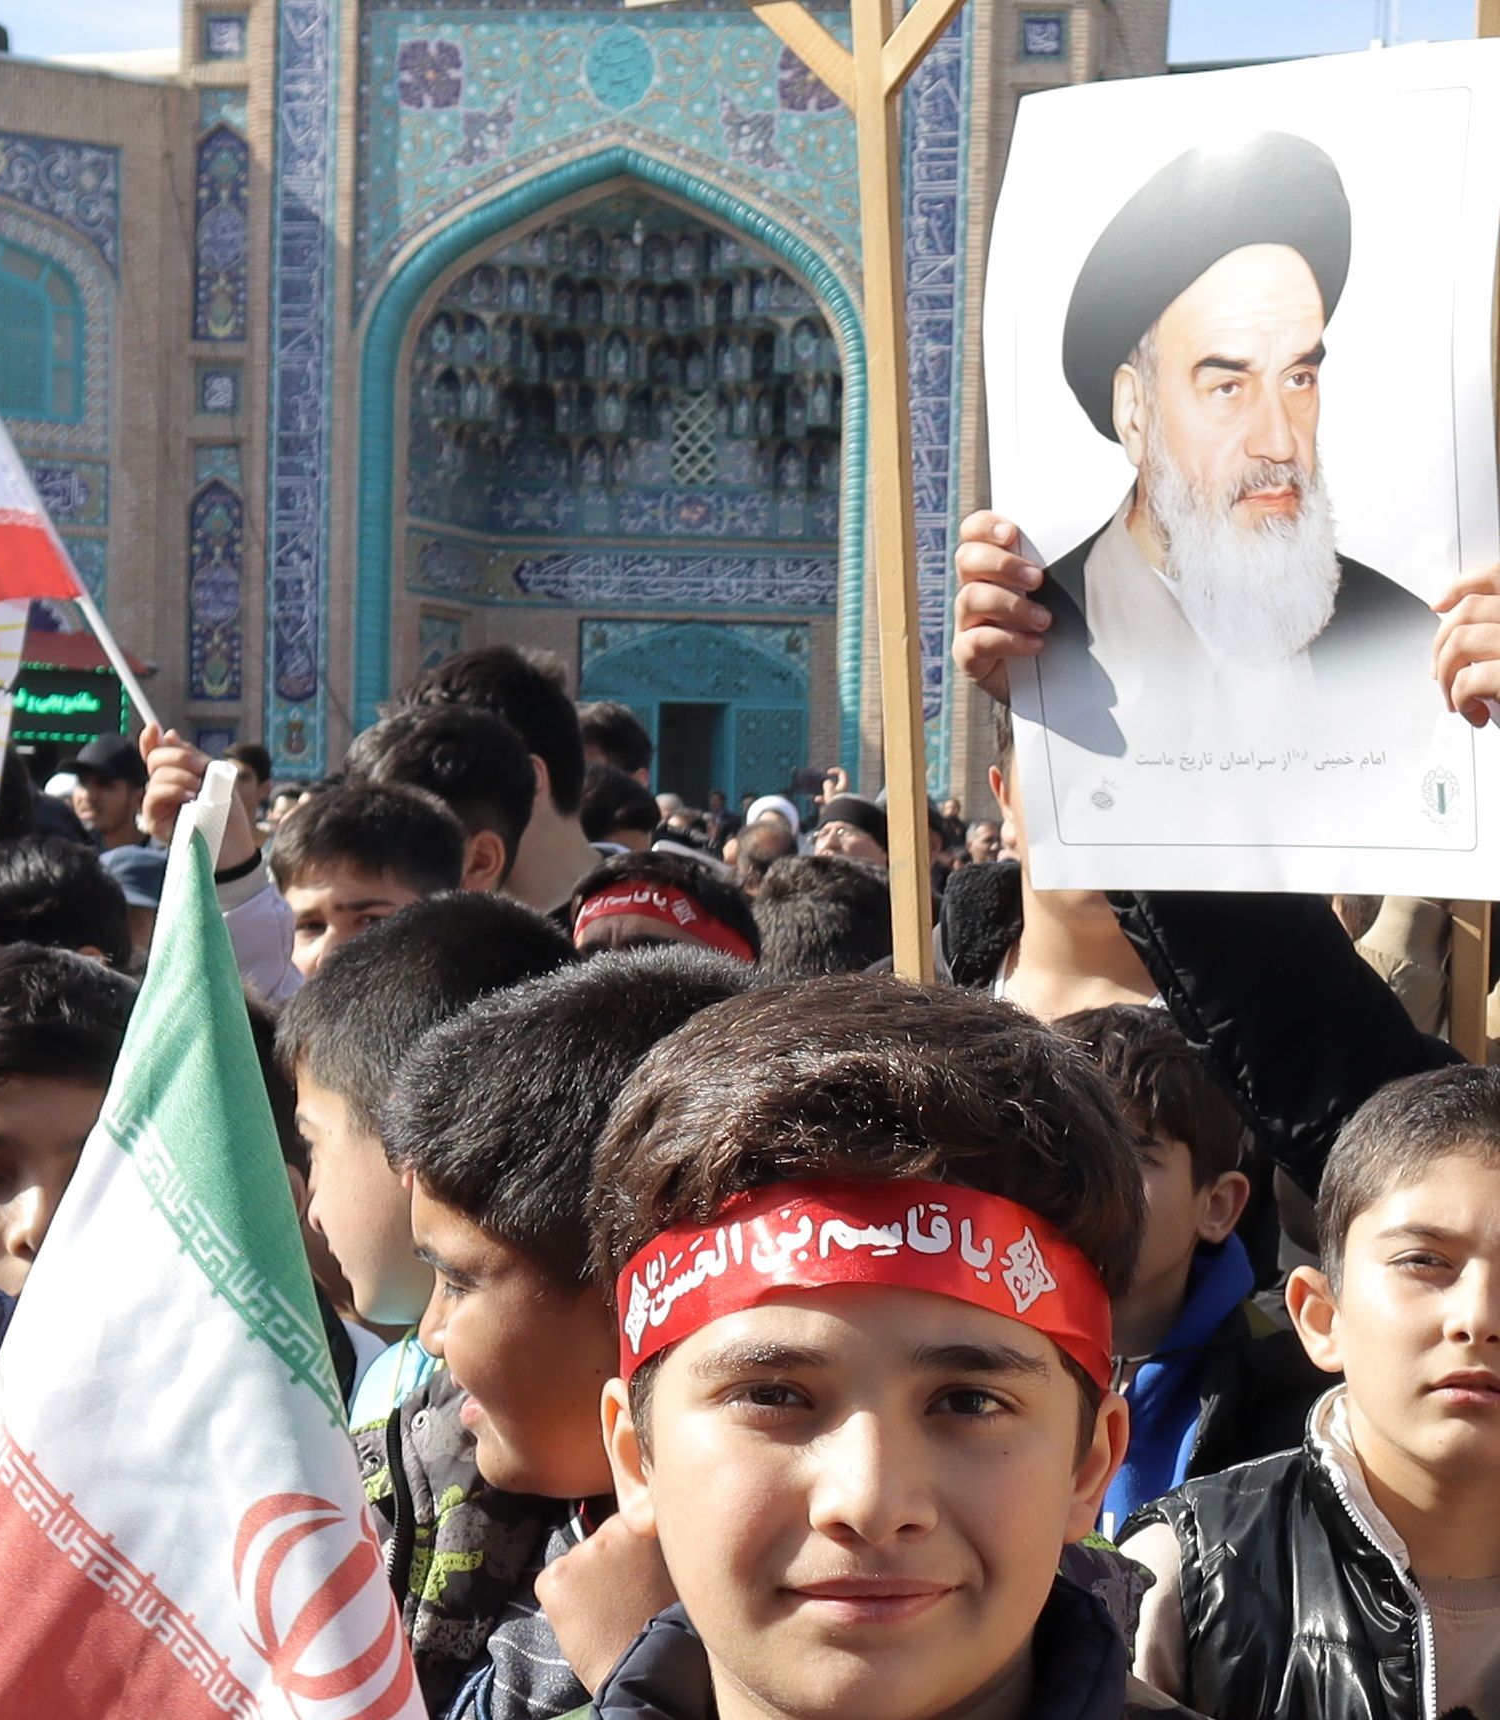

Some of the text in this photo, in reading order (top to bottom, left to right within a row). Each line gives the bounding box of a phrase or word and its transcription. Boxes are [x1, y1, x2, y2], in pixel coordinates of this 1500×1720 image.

[1135, 750, 1174, 766] ماست
[1180, 751, 1213, 771] تاریخ
[1281, 752, 1292, 770] از
[1313, 750, 1353, 771] خمینی
[1360, 750, 1386, 770] امام
[960, 1215, 994, 1282] یا
